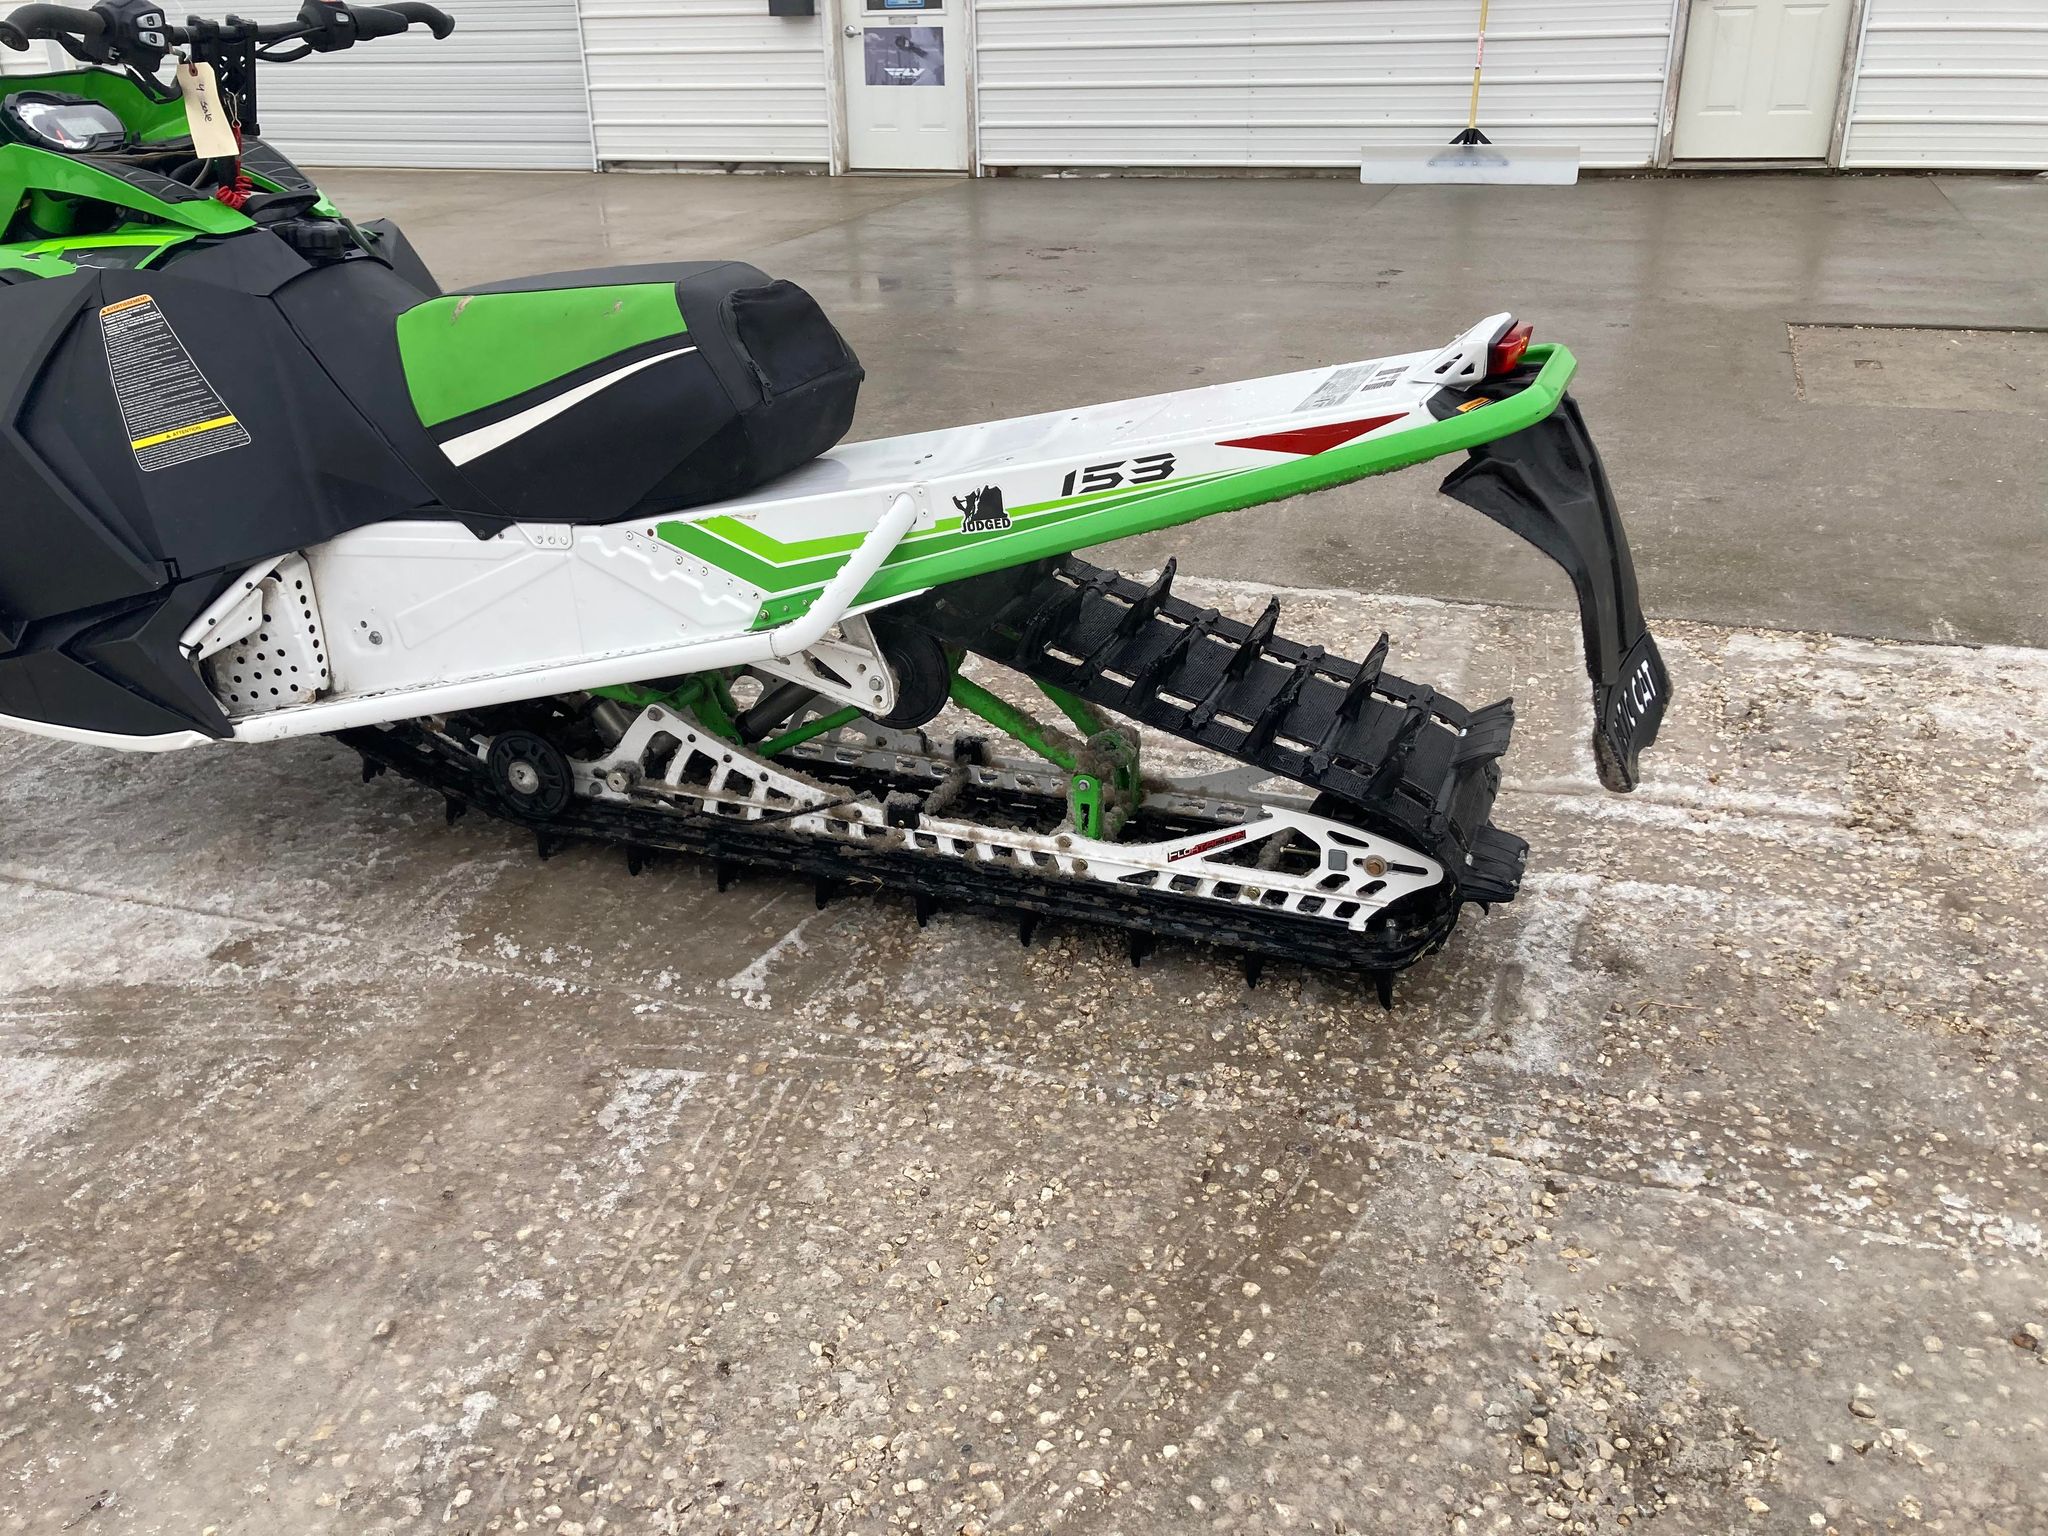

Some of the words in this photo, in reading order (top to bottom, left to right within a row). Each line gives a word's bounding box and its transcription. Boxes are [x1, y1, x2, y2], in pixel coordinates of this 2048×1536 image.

[172, 425, 202, 437] ATTENTION
[1061, 452, 1177, 497] 153
[961, 517, 1012, 533] JUDGED
[1631, 659, 1657, 715] CAT
